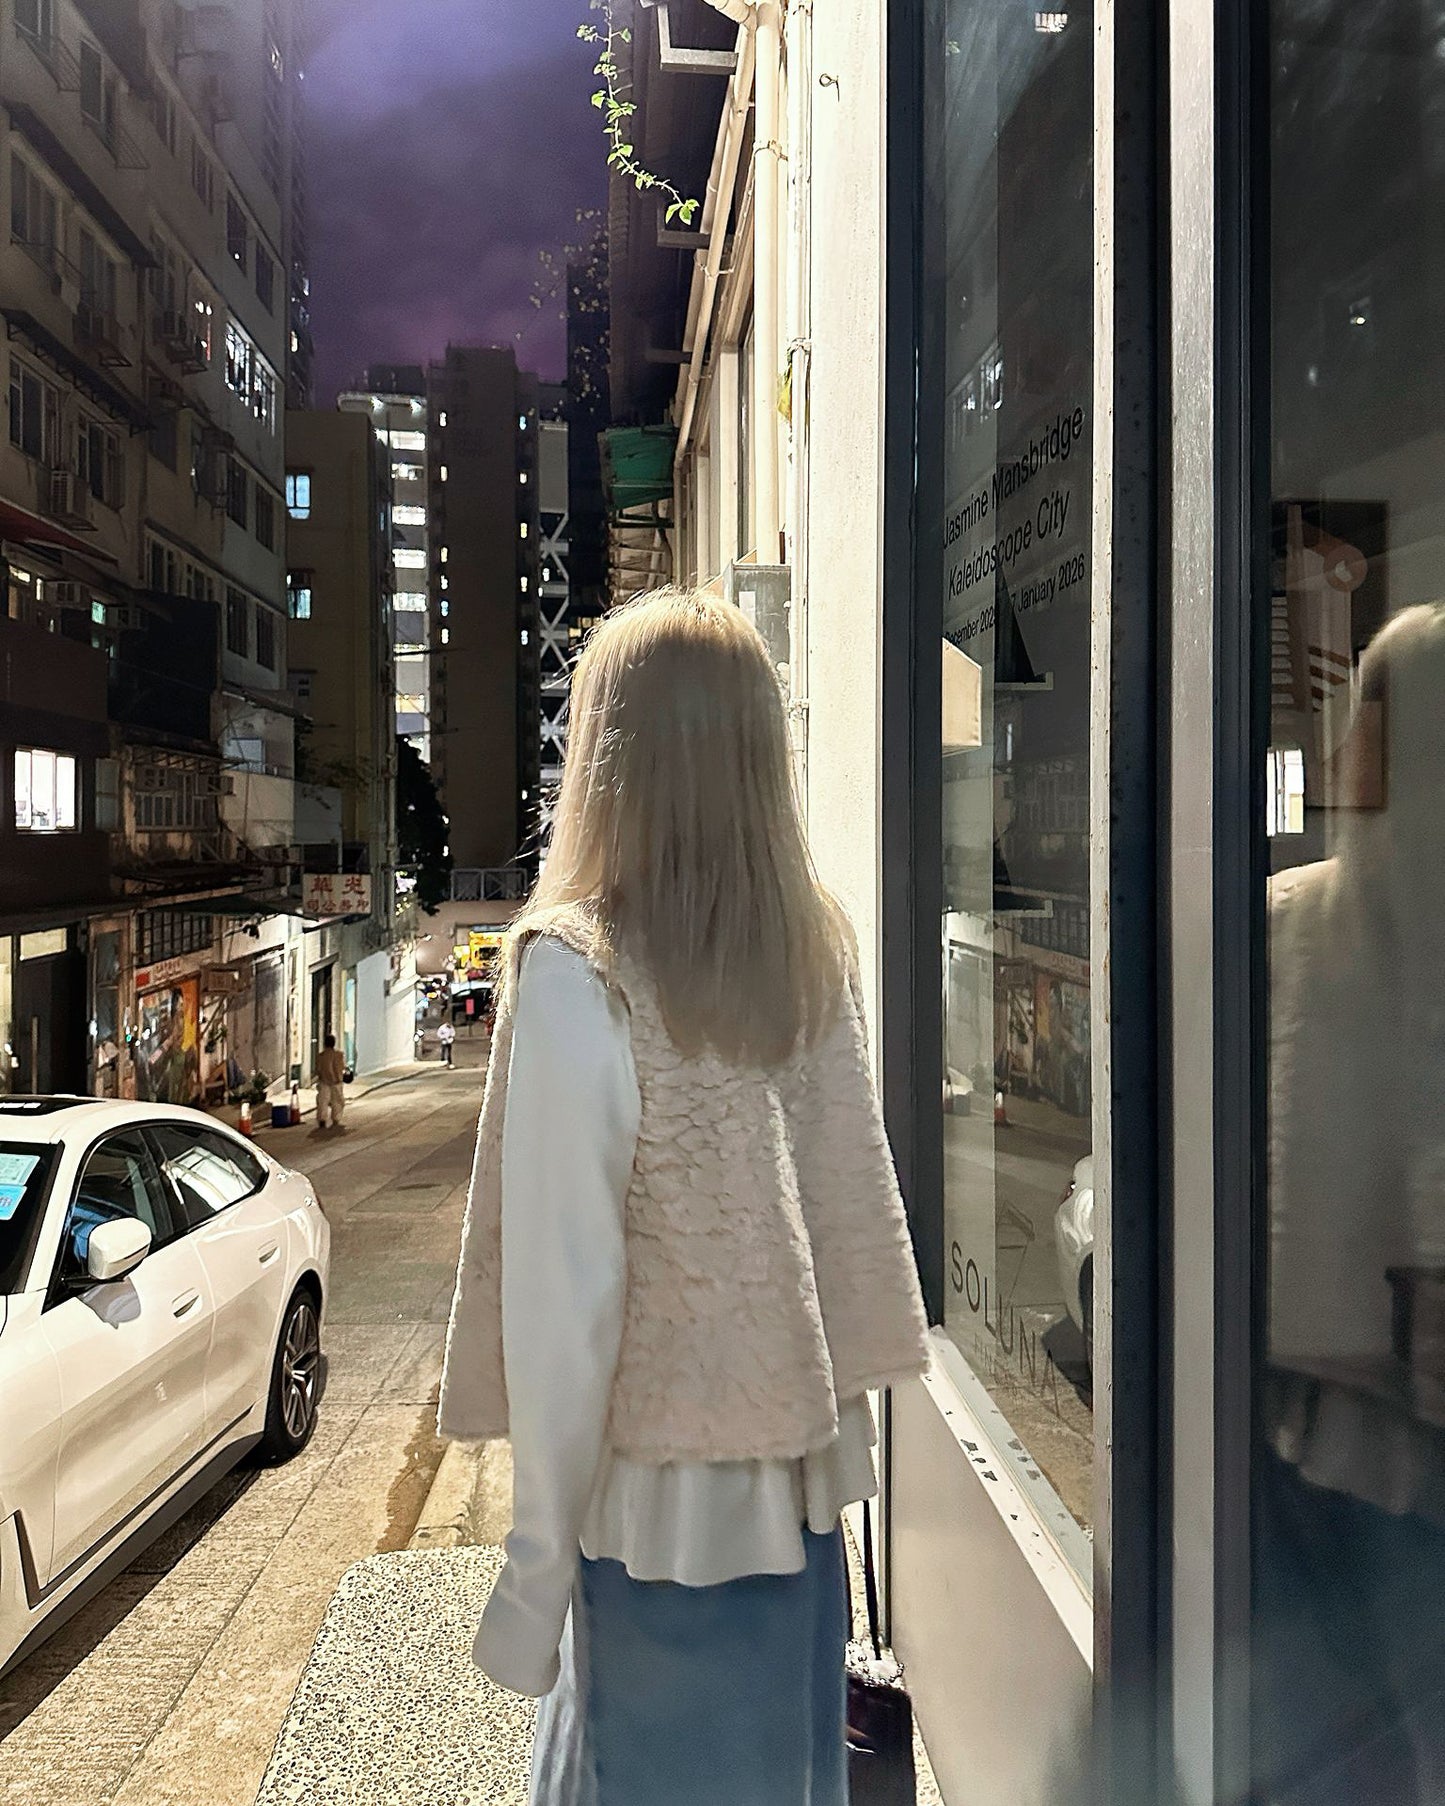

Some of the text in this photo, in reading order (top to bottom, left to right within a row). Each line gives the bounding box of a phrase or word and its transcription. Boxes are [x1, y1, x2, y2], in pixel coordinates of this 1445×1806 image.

[943, 407, 1083, 549] Jasmine Mansbridge
[948, 490, 1070, 600] Kaleidoscope City
[980, 605, 996, 633] 202
[1018, 576, 1056, 613] January
[1058, 553, 1085, 591] 2026
[952, 1240, 1060, 1418] SOLUNA
